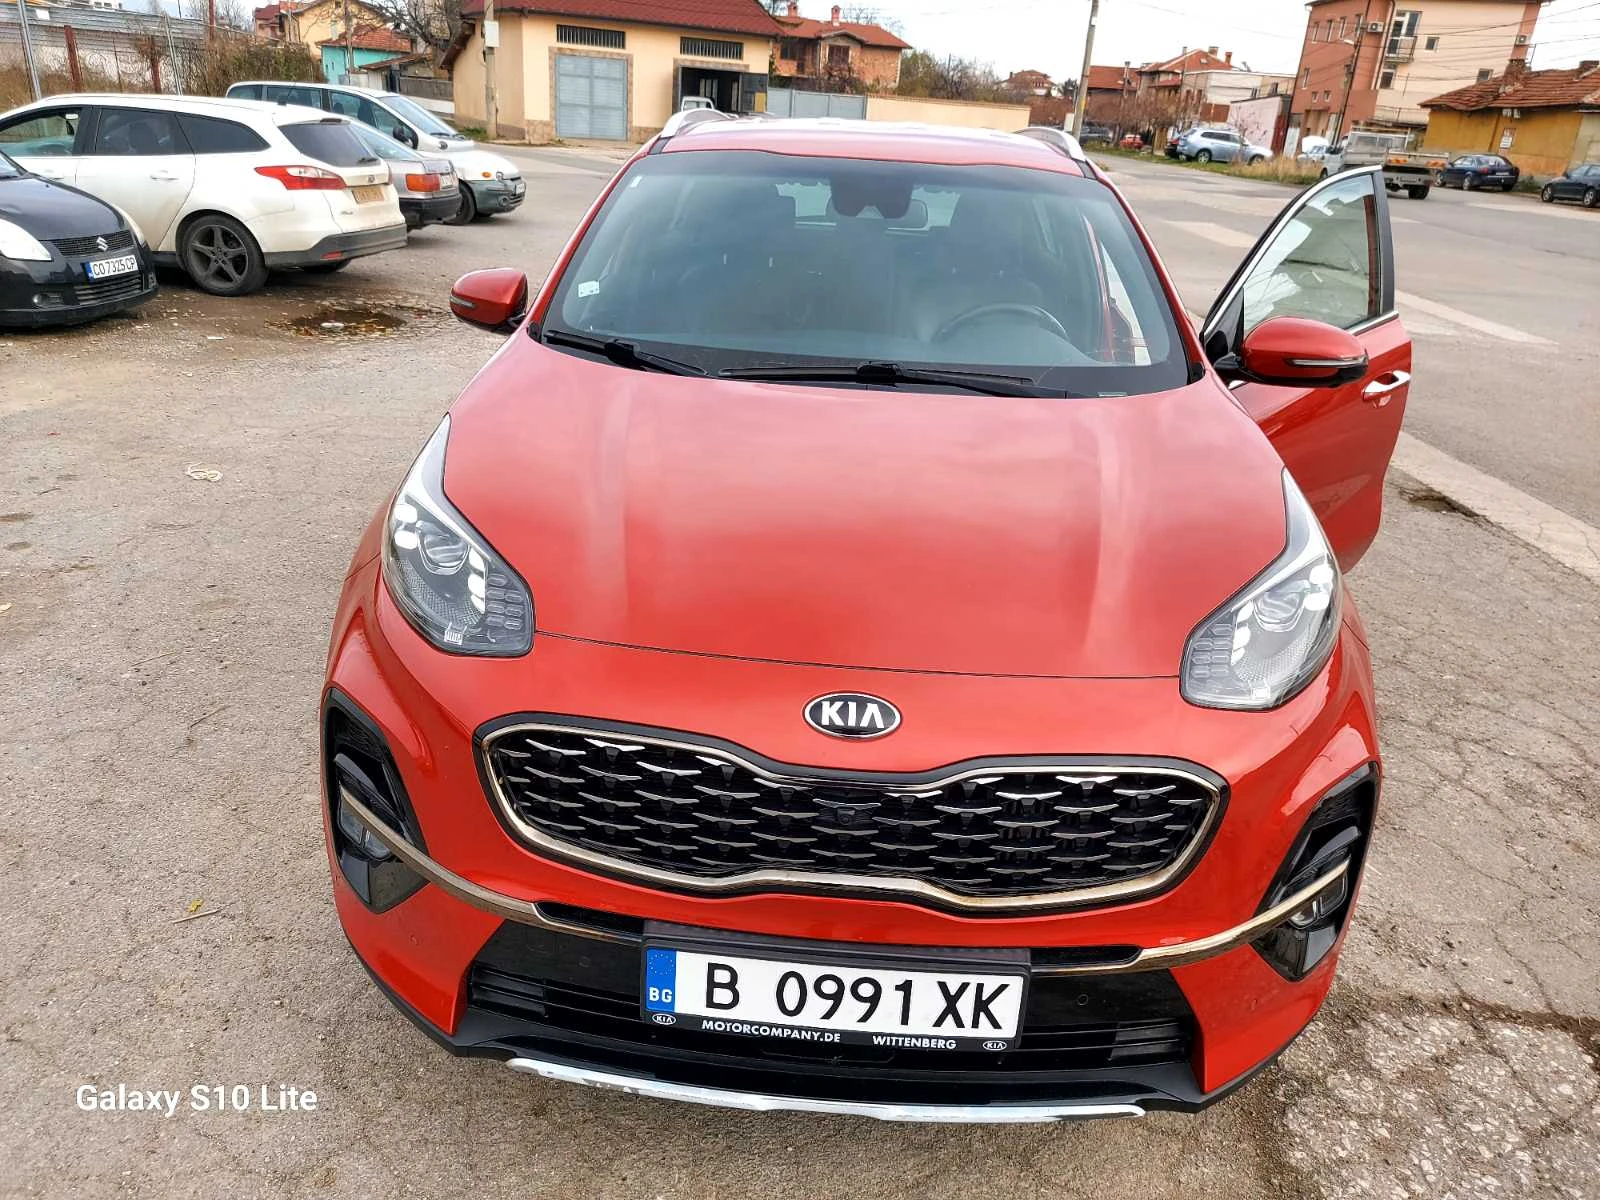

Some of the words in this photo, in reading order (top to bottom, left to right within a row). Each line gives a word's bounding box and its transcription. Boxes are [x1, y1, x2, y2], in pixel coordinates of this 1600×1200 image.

[821, 701, 884, 728] KIA
[649, 986, 673, 1003] BG
[706, 962, 740, 1010] B
[776, 970, 913, 1026] 0991
[932, 981, 1011, 1030] XK
[701, 1019, 841, 1043] MOTORCOMPANY.DE
[872, 1035, 957, 1050] WITTENBERG
